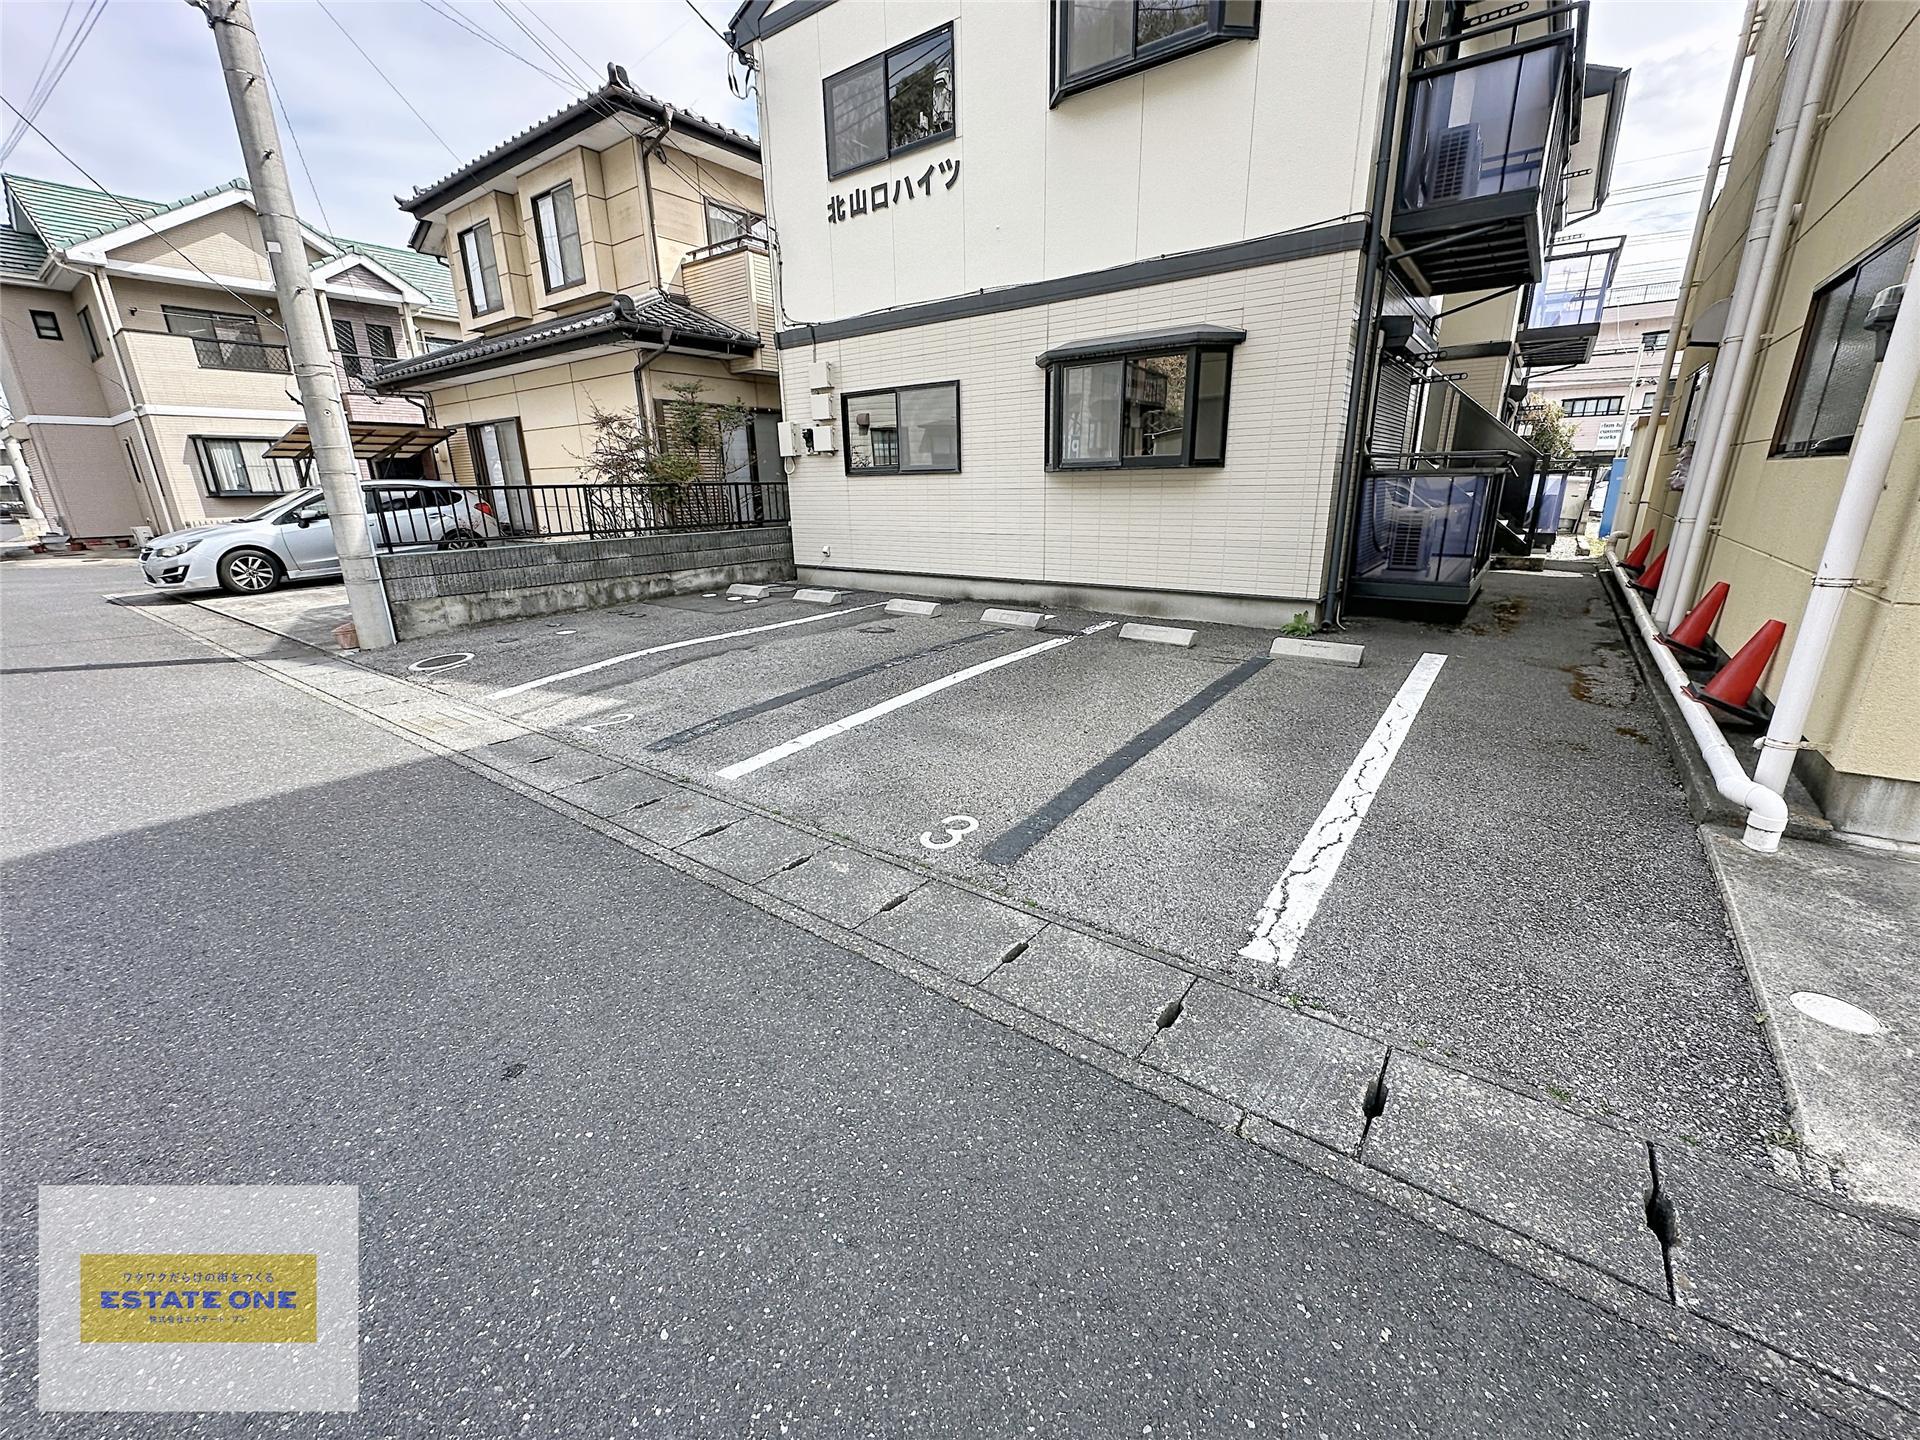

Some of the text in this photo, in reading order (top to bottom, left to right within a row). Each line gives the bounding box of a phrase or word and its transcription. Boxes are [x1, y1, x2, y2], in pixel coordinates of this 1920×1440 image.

[827, 158, 960, 224] 北山口ハイツ
[920, 815, 979, 849] 3
